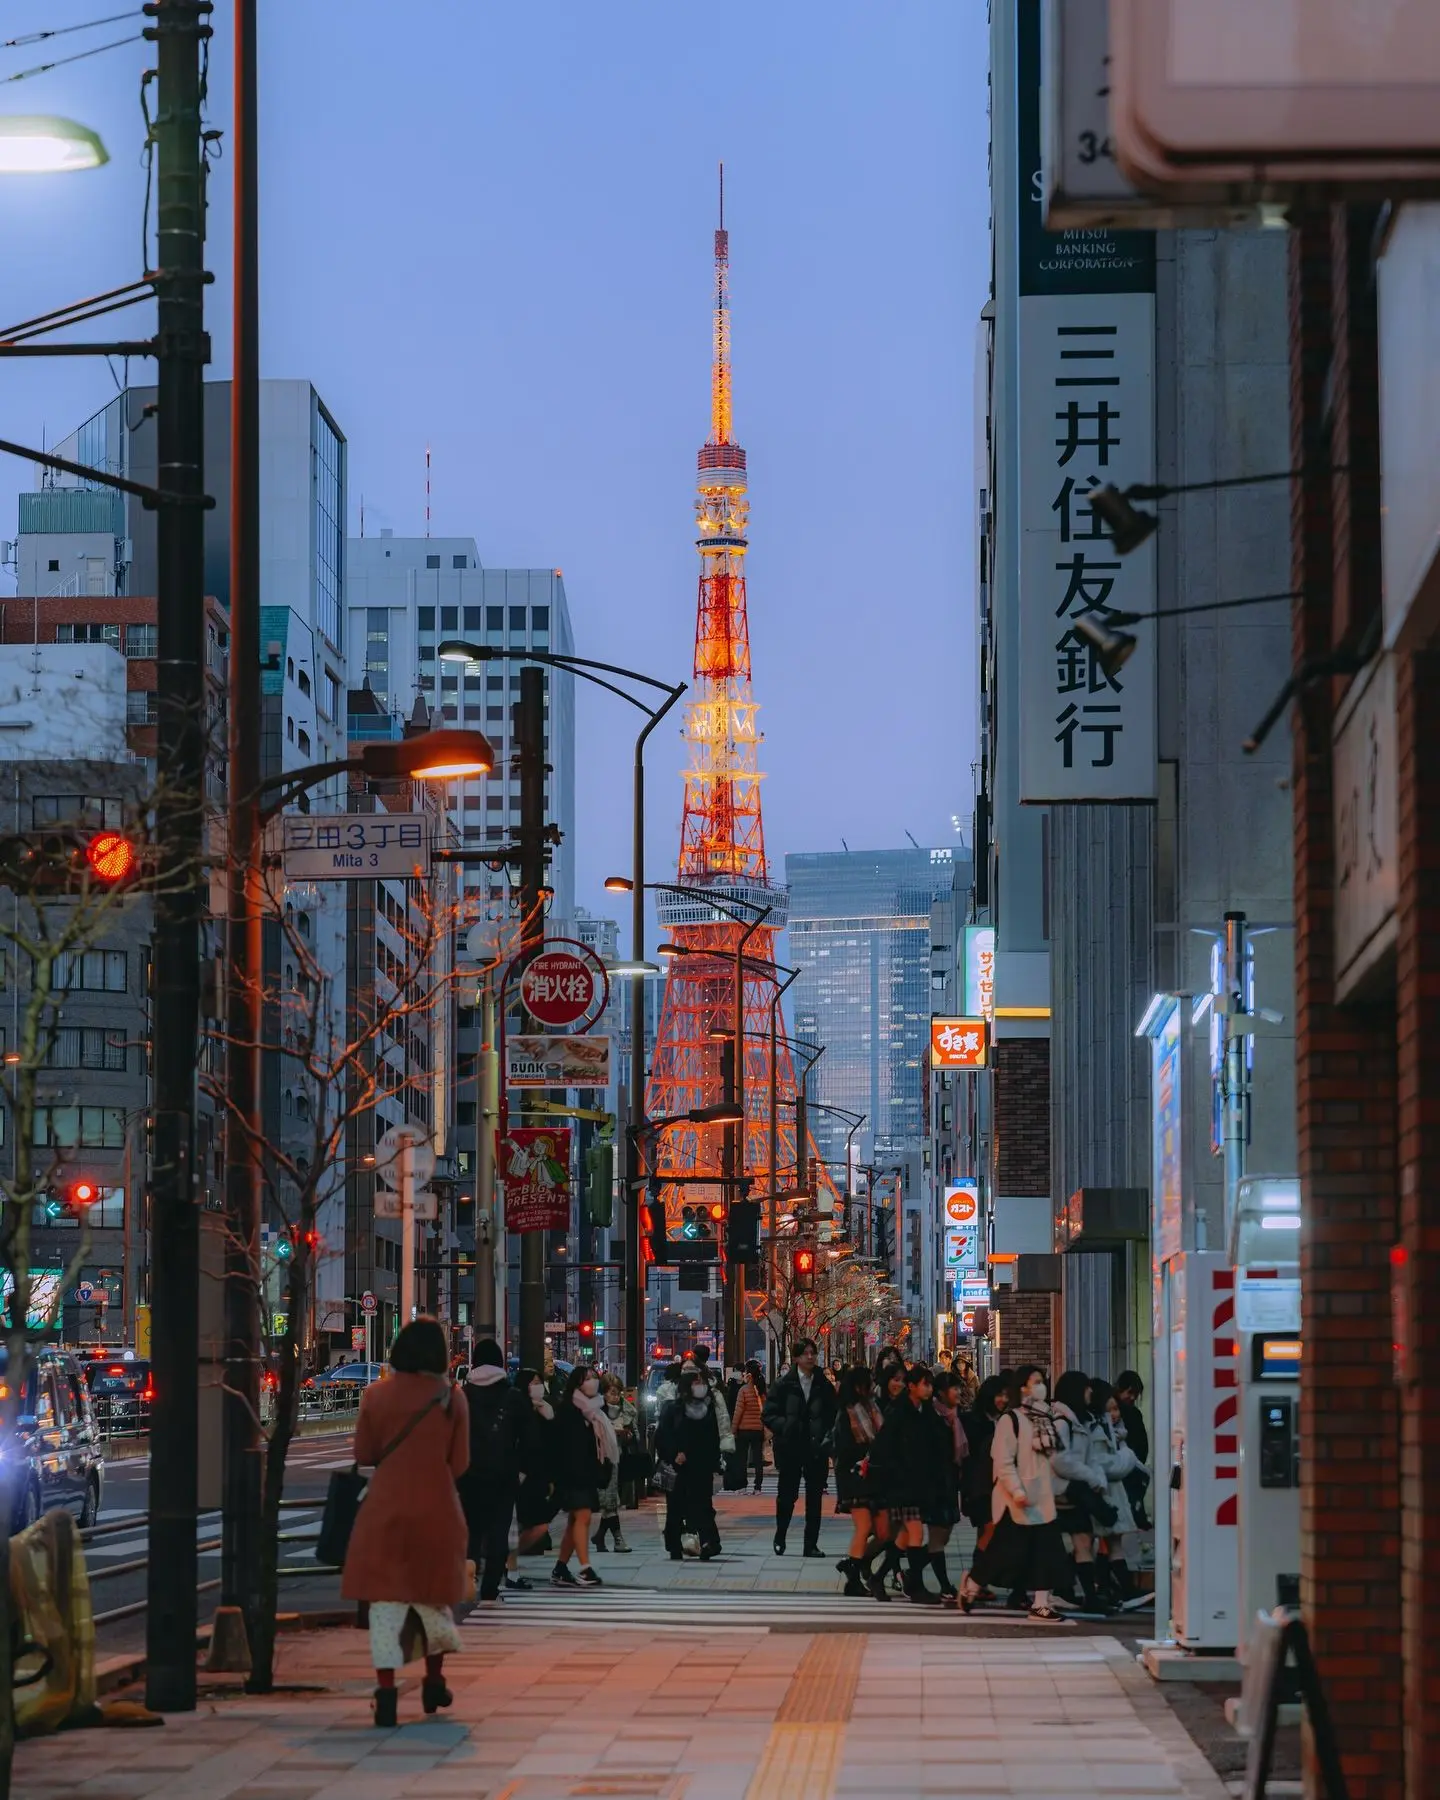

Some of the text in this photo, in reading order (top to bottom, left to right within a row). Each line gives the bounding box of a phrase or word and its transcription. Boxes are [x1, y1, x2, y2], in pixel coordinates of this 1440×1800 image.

[1063, 227, 1108, 240] MITSUI
[1055, 242, 1116, 255] BANKING
[1039, 257, 1134, 270] CORPORATION
[1052, 326, 1125, 768] 三井住友銀行
[290, 824, 421, 850] 三田3丁目
[332, 853, 379, 867] Mita 3
[534, 961, 581, 970] FIRE HYDRANT
[528, 974, 589, 1002] 消火栓
[937, 1025, 979, 1054] すき家
[510, 1062, 544, 1073] BUNK
[521, 1183, 546, 1195] BIG
[950, 1203, 974, 1213] ガスト
[83, 1290, 88, 1299] 1
